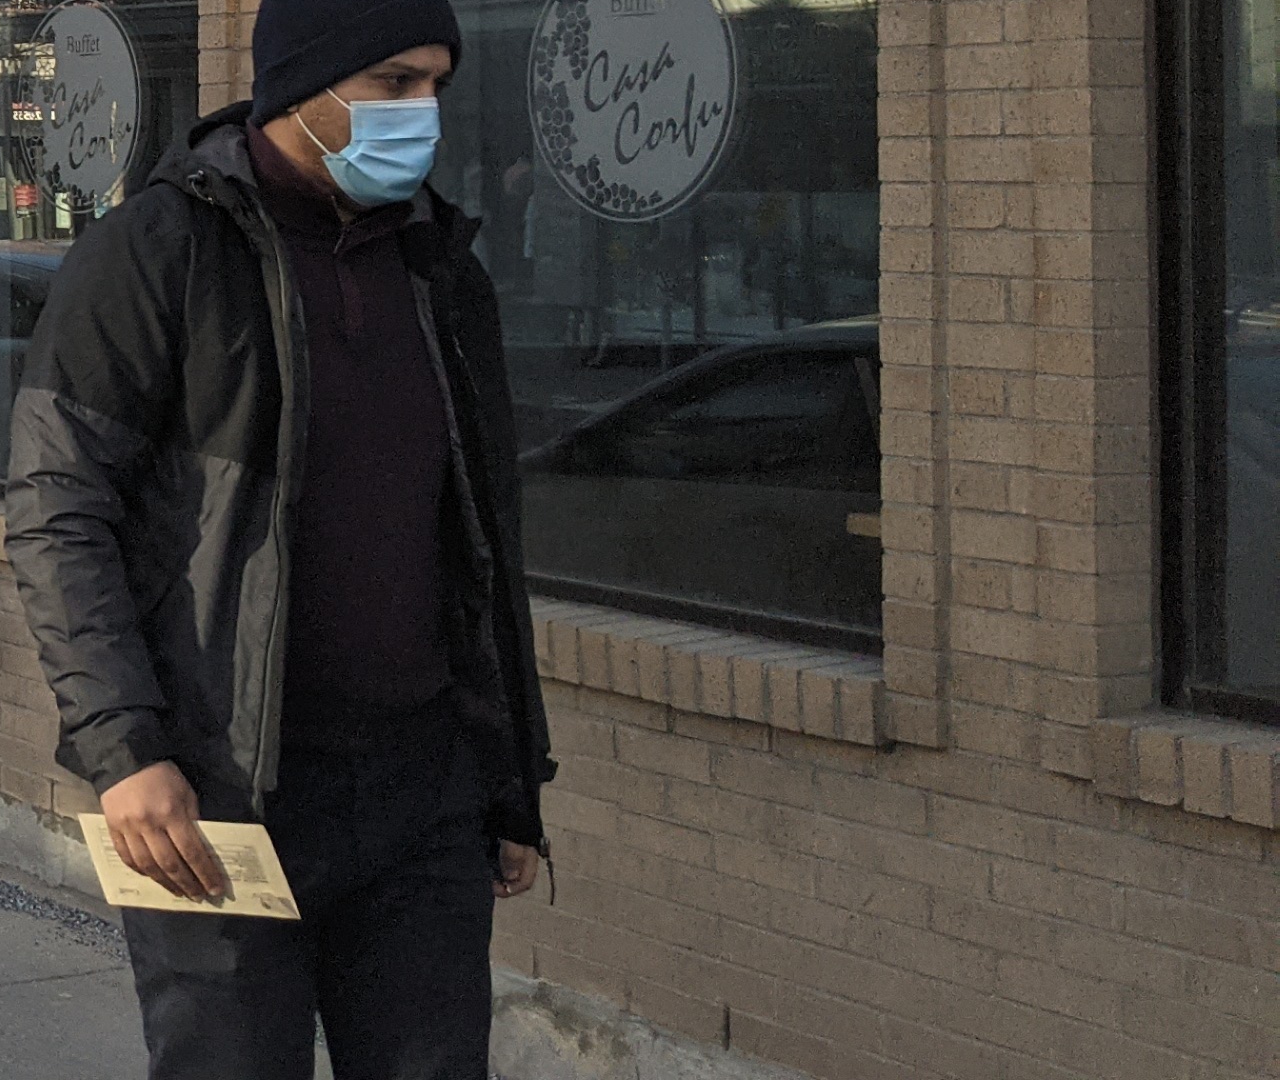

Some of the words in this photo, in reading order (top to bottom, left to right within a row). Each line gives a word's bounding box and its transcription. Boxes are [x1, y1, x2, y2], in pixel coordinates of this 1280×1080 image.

[66, 34, 100, 53] Buffet
[52, 75, 106, 130] Casa
[584, 41, 675, 113] Casa
[614, 73, 723, 165] Corfu
